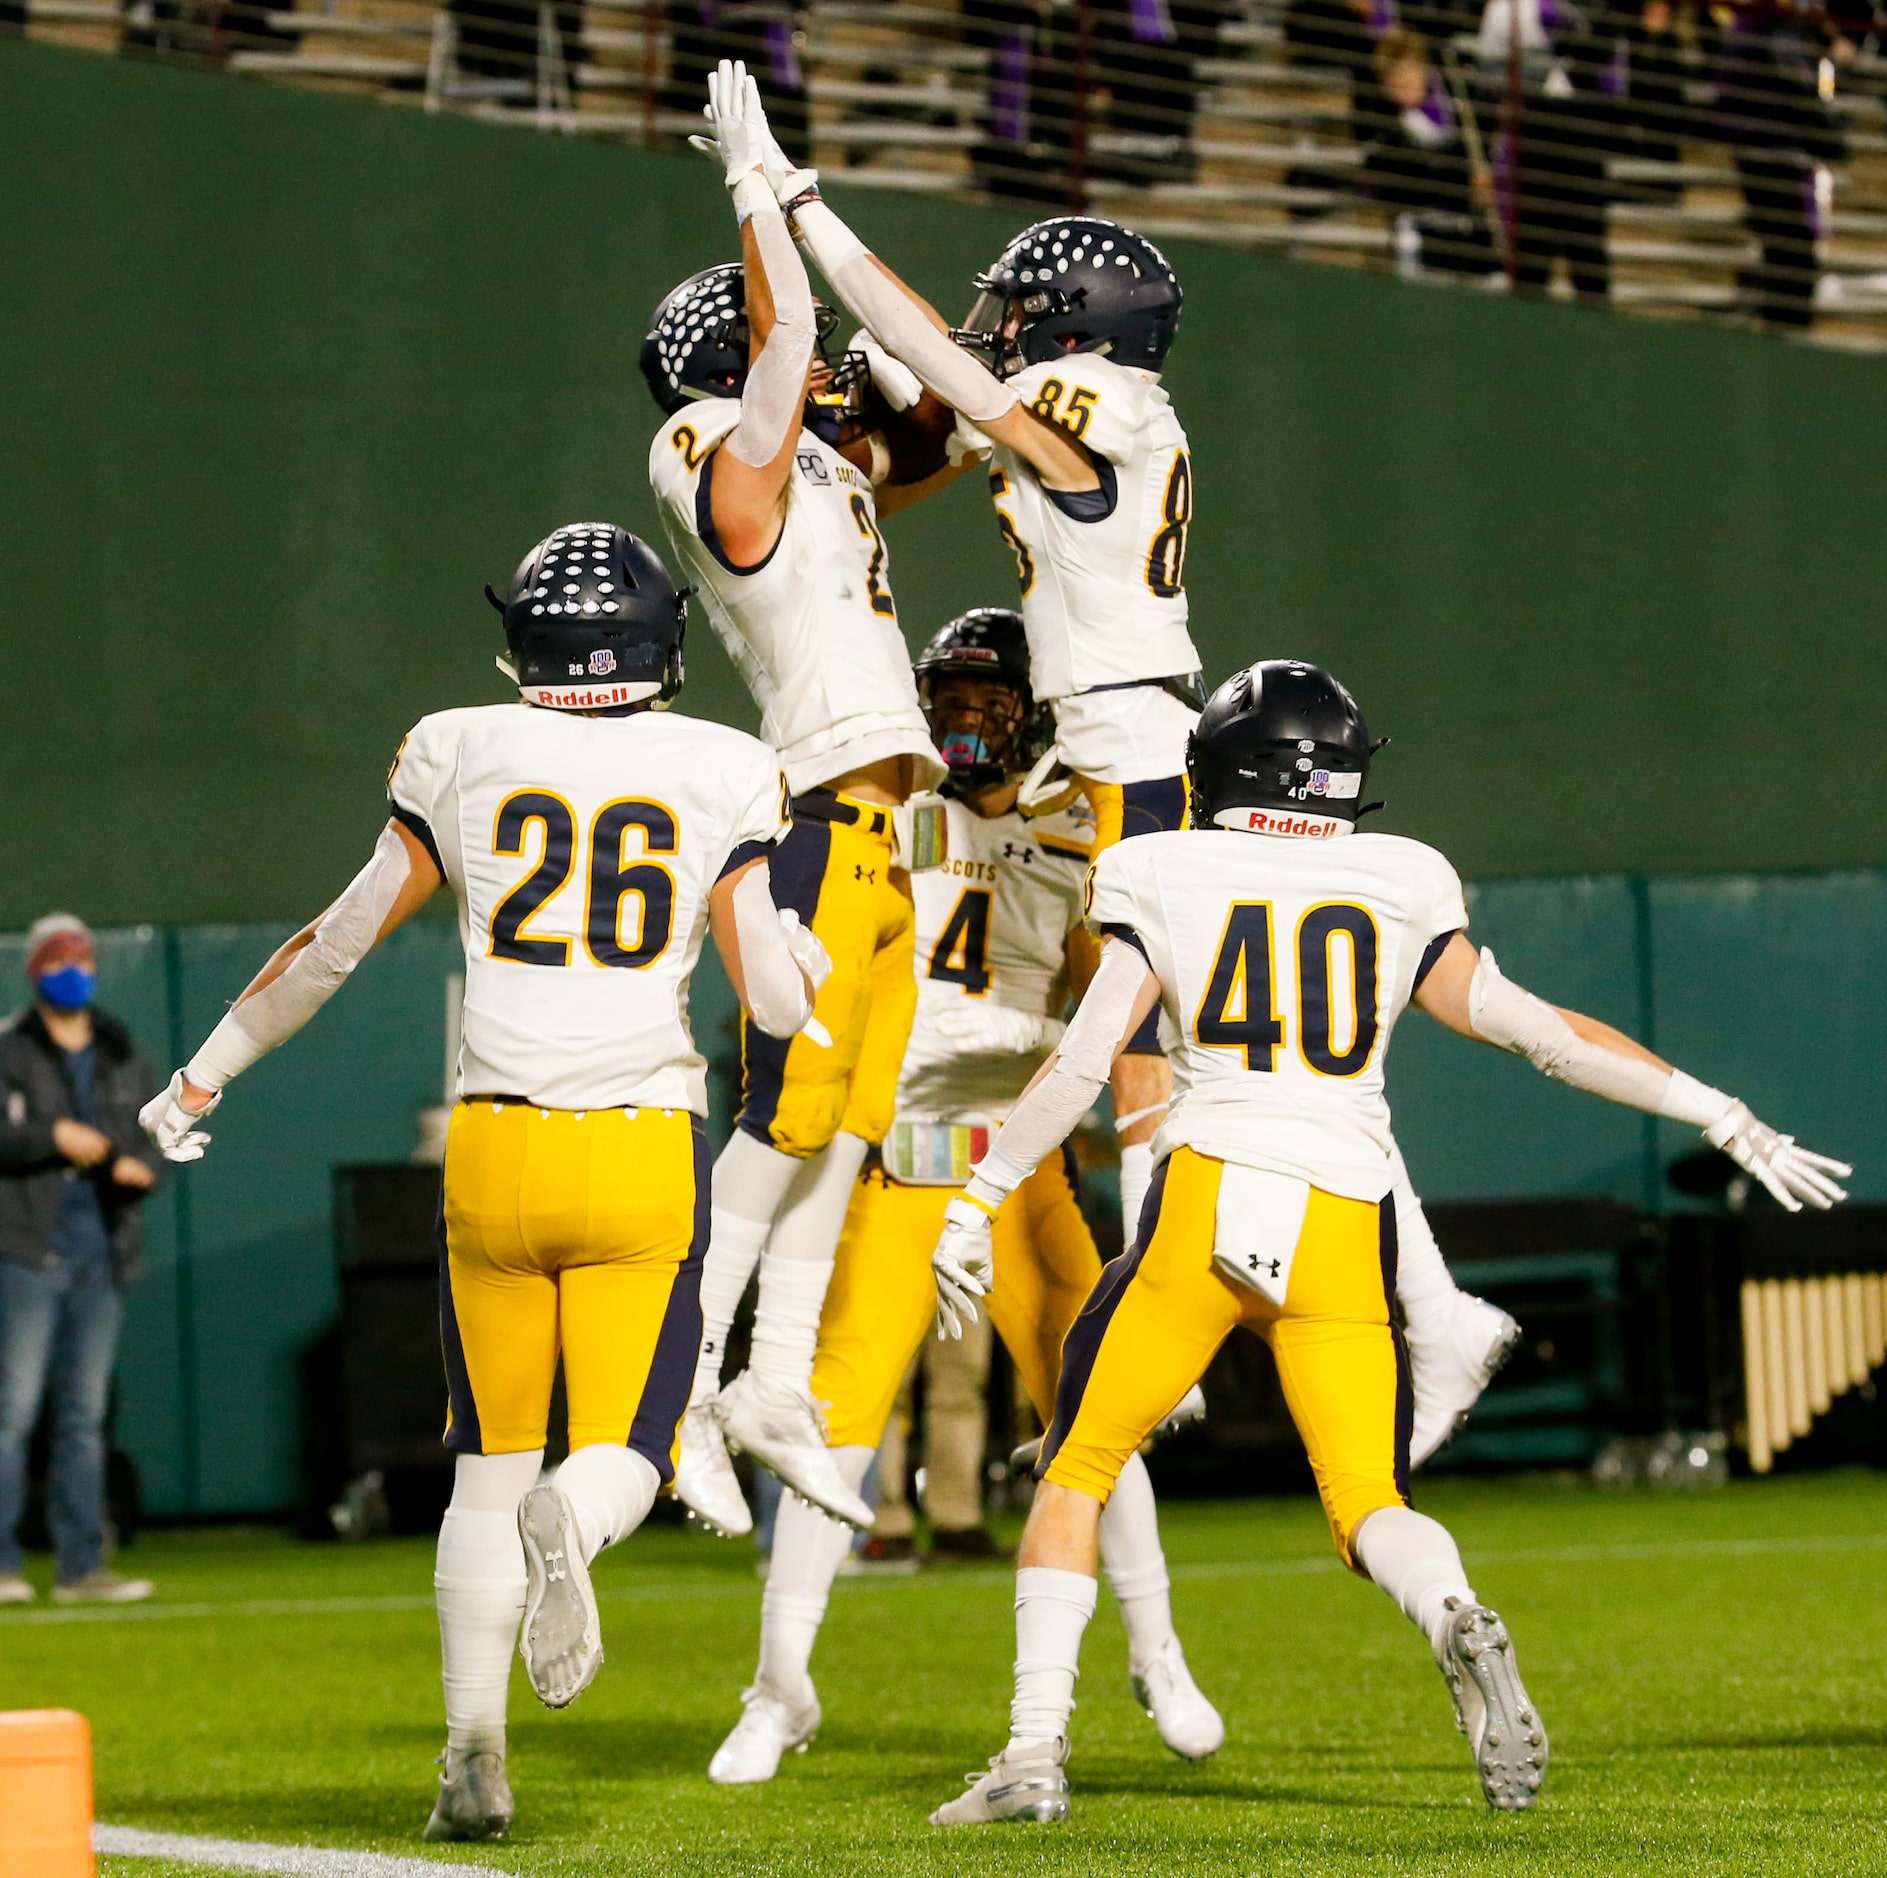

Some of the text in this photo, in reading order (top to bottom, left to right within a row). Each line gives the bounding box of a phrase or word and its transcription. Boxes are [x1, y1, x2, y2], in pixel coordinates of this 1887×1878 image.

[1033, 376, 1101, 440] 85
[671, 423, 708, 473] 2
[848, 491, 895, 619] 2
[568, 663, 584, 676] 26
[538, 687, 628, 707] Riddell
[1288, 786, 1307, 800] 40
[1249, 812, 1337, 837] Riddell
[486, 787, 680, 970] 26
[942, 858, 997, 882] SCOTS
[926, 886, 995, 998] 4
[1195, 900, 1380, 1079] 40
